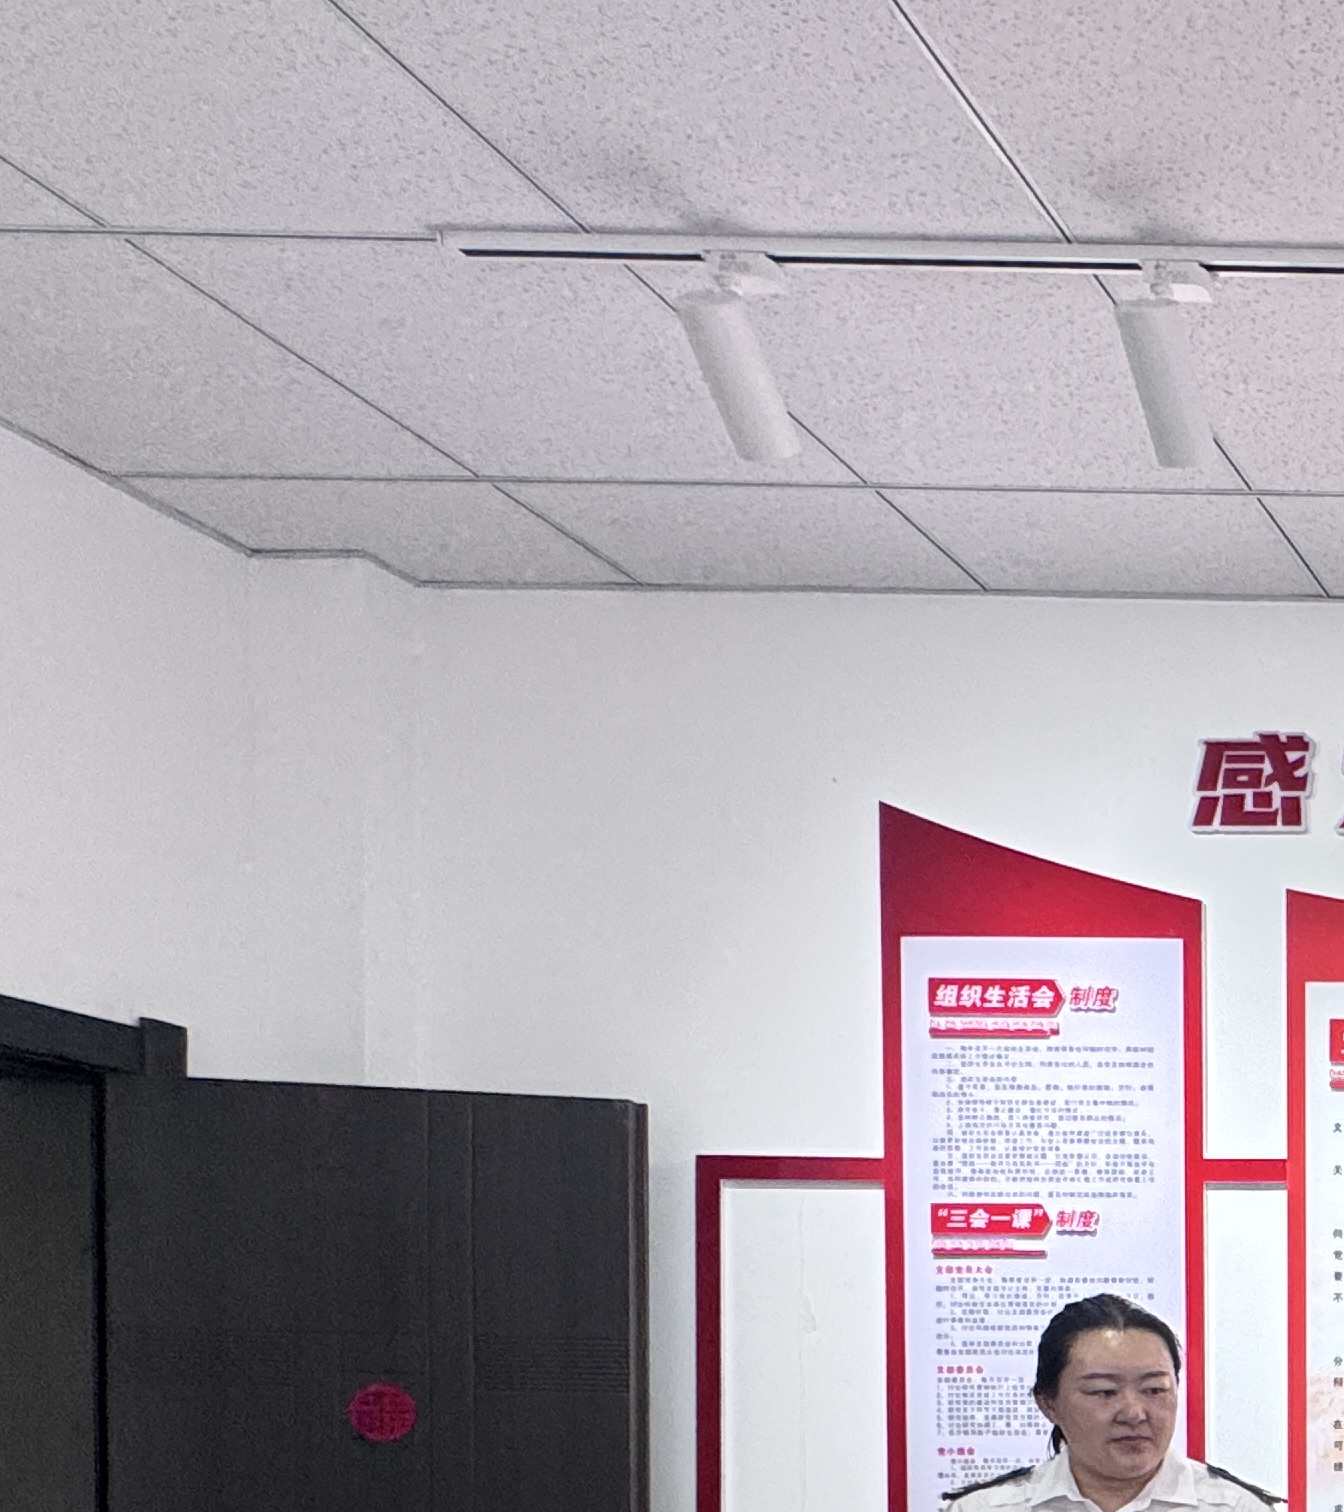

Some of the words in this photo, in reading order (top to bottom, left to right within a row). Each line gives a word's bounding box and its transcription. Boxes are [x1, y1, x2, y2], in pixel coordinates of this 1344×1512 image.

[934, 984, 1055, 1008] 组织生活会
[1069, 986, 1117, 1010] 制度
[1056, 1210, 1099, 1231] 制度
